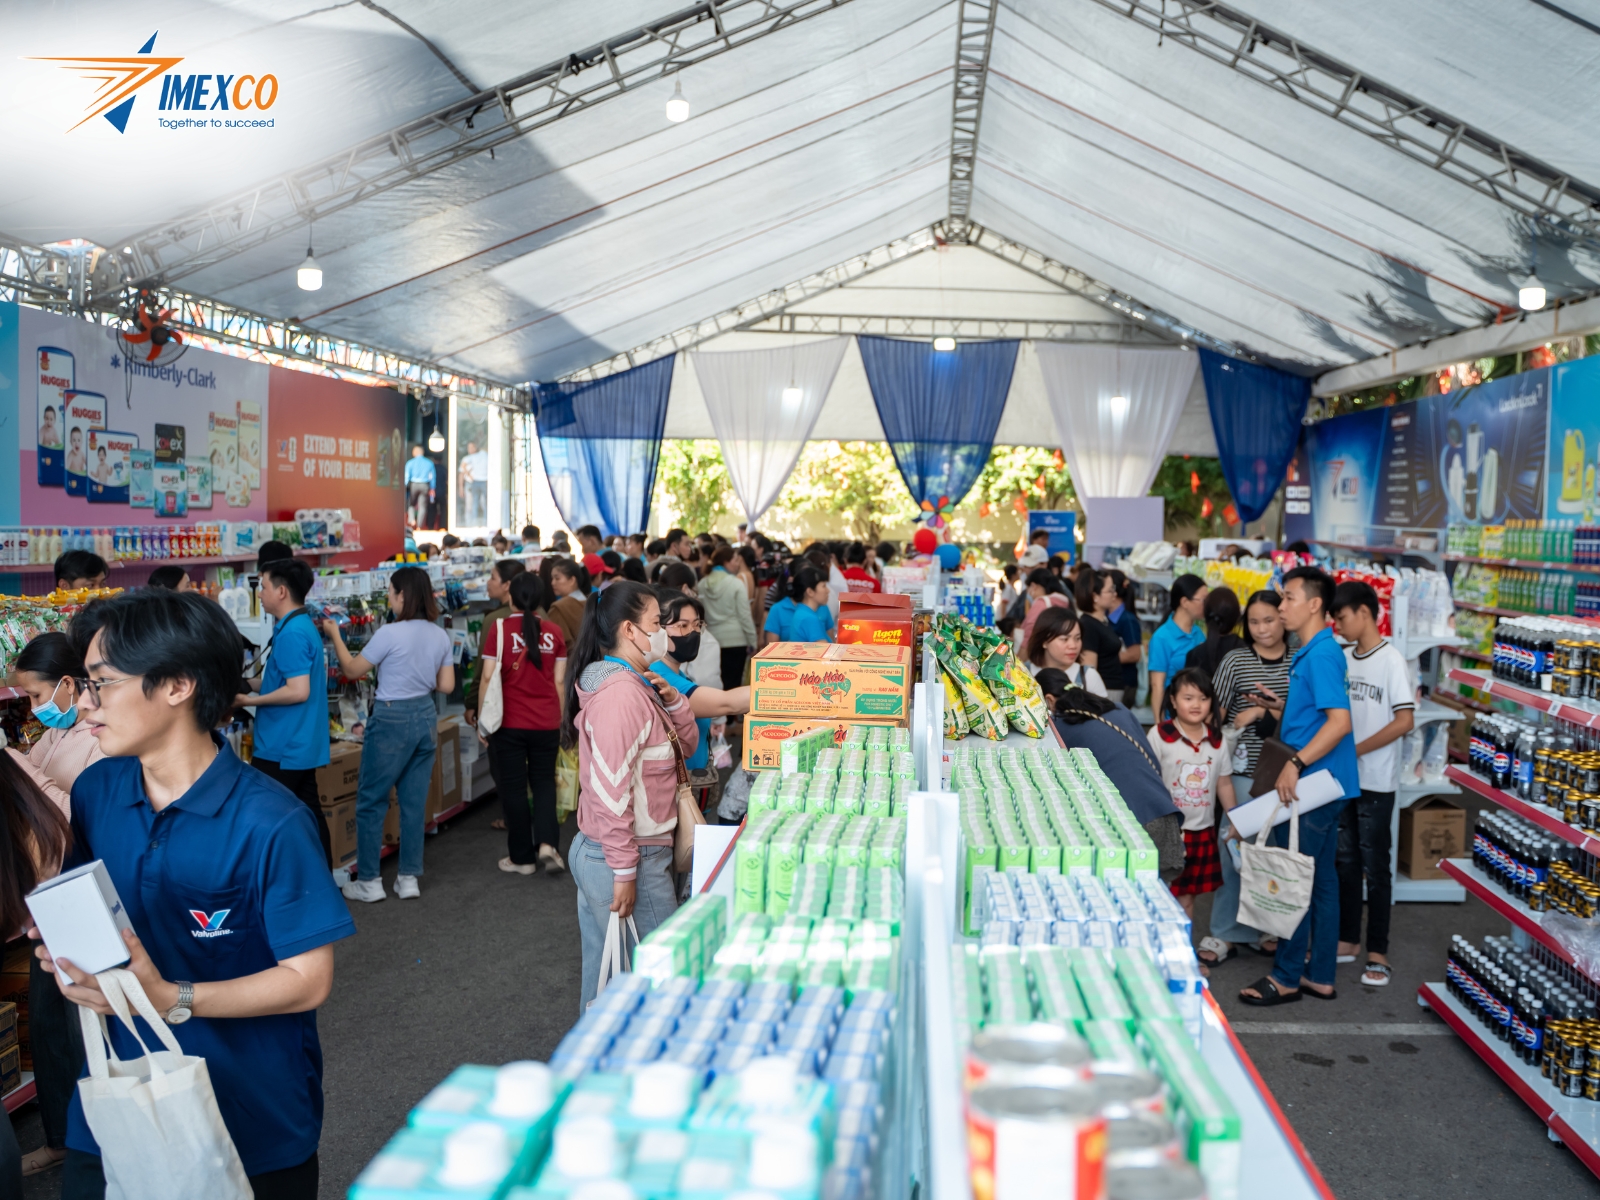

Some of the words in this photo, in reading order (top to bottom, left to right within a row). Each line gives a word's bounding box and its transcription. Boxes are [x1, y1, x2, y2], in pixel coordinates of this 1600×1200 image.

[40, 374, 71, 388] HUGGIES
[124, 355, 217, 390] Kimberly-Clark
[72, 407, 102, 420] HUGGIES
[303, 434, 336, 456] EXTEND
[338, 437, 353, 457] THE
[354, 440, 370, 459] LIFE
[303, 458, 316, 478] OF
[318, 459, 342, 479] YOUR
[344, 461, 371, 481] ENGINE
[510, 632, 554, 650] NS
[191, 929, 231, 938] Valvoline
